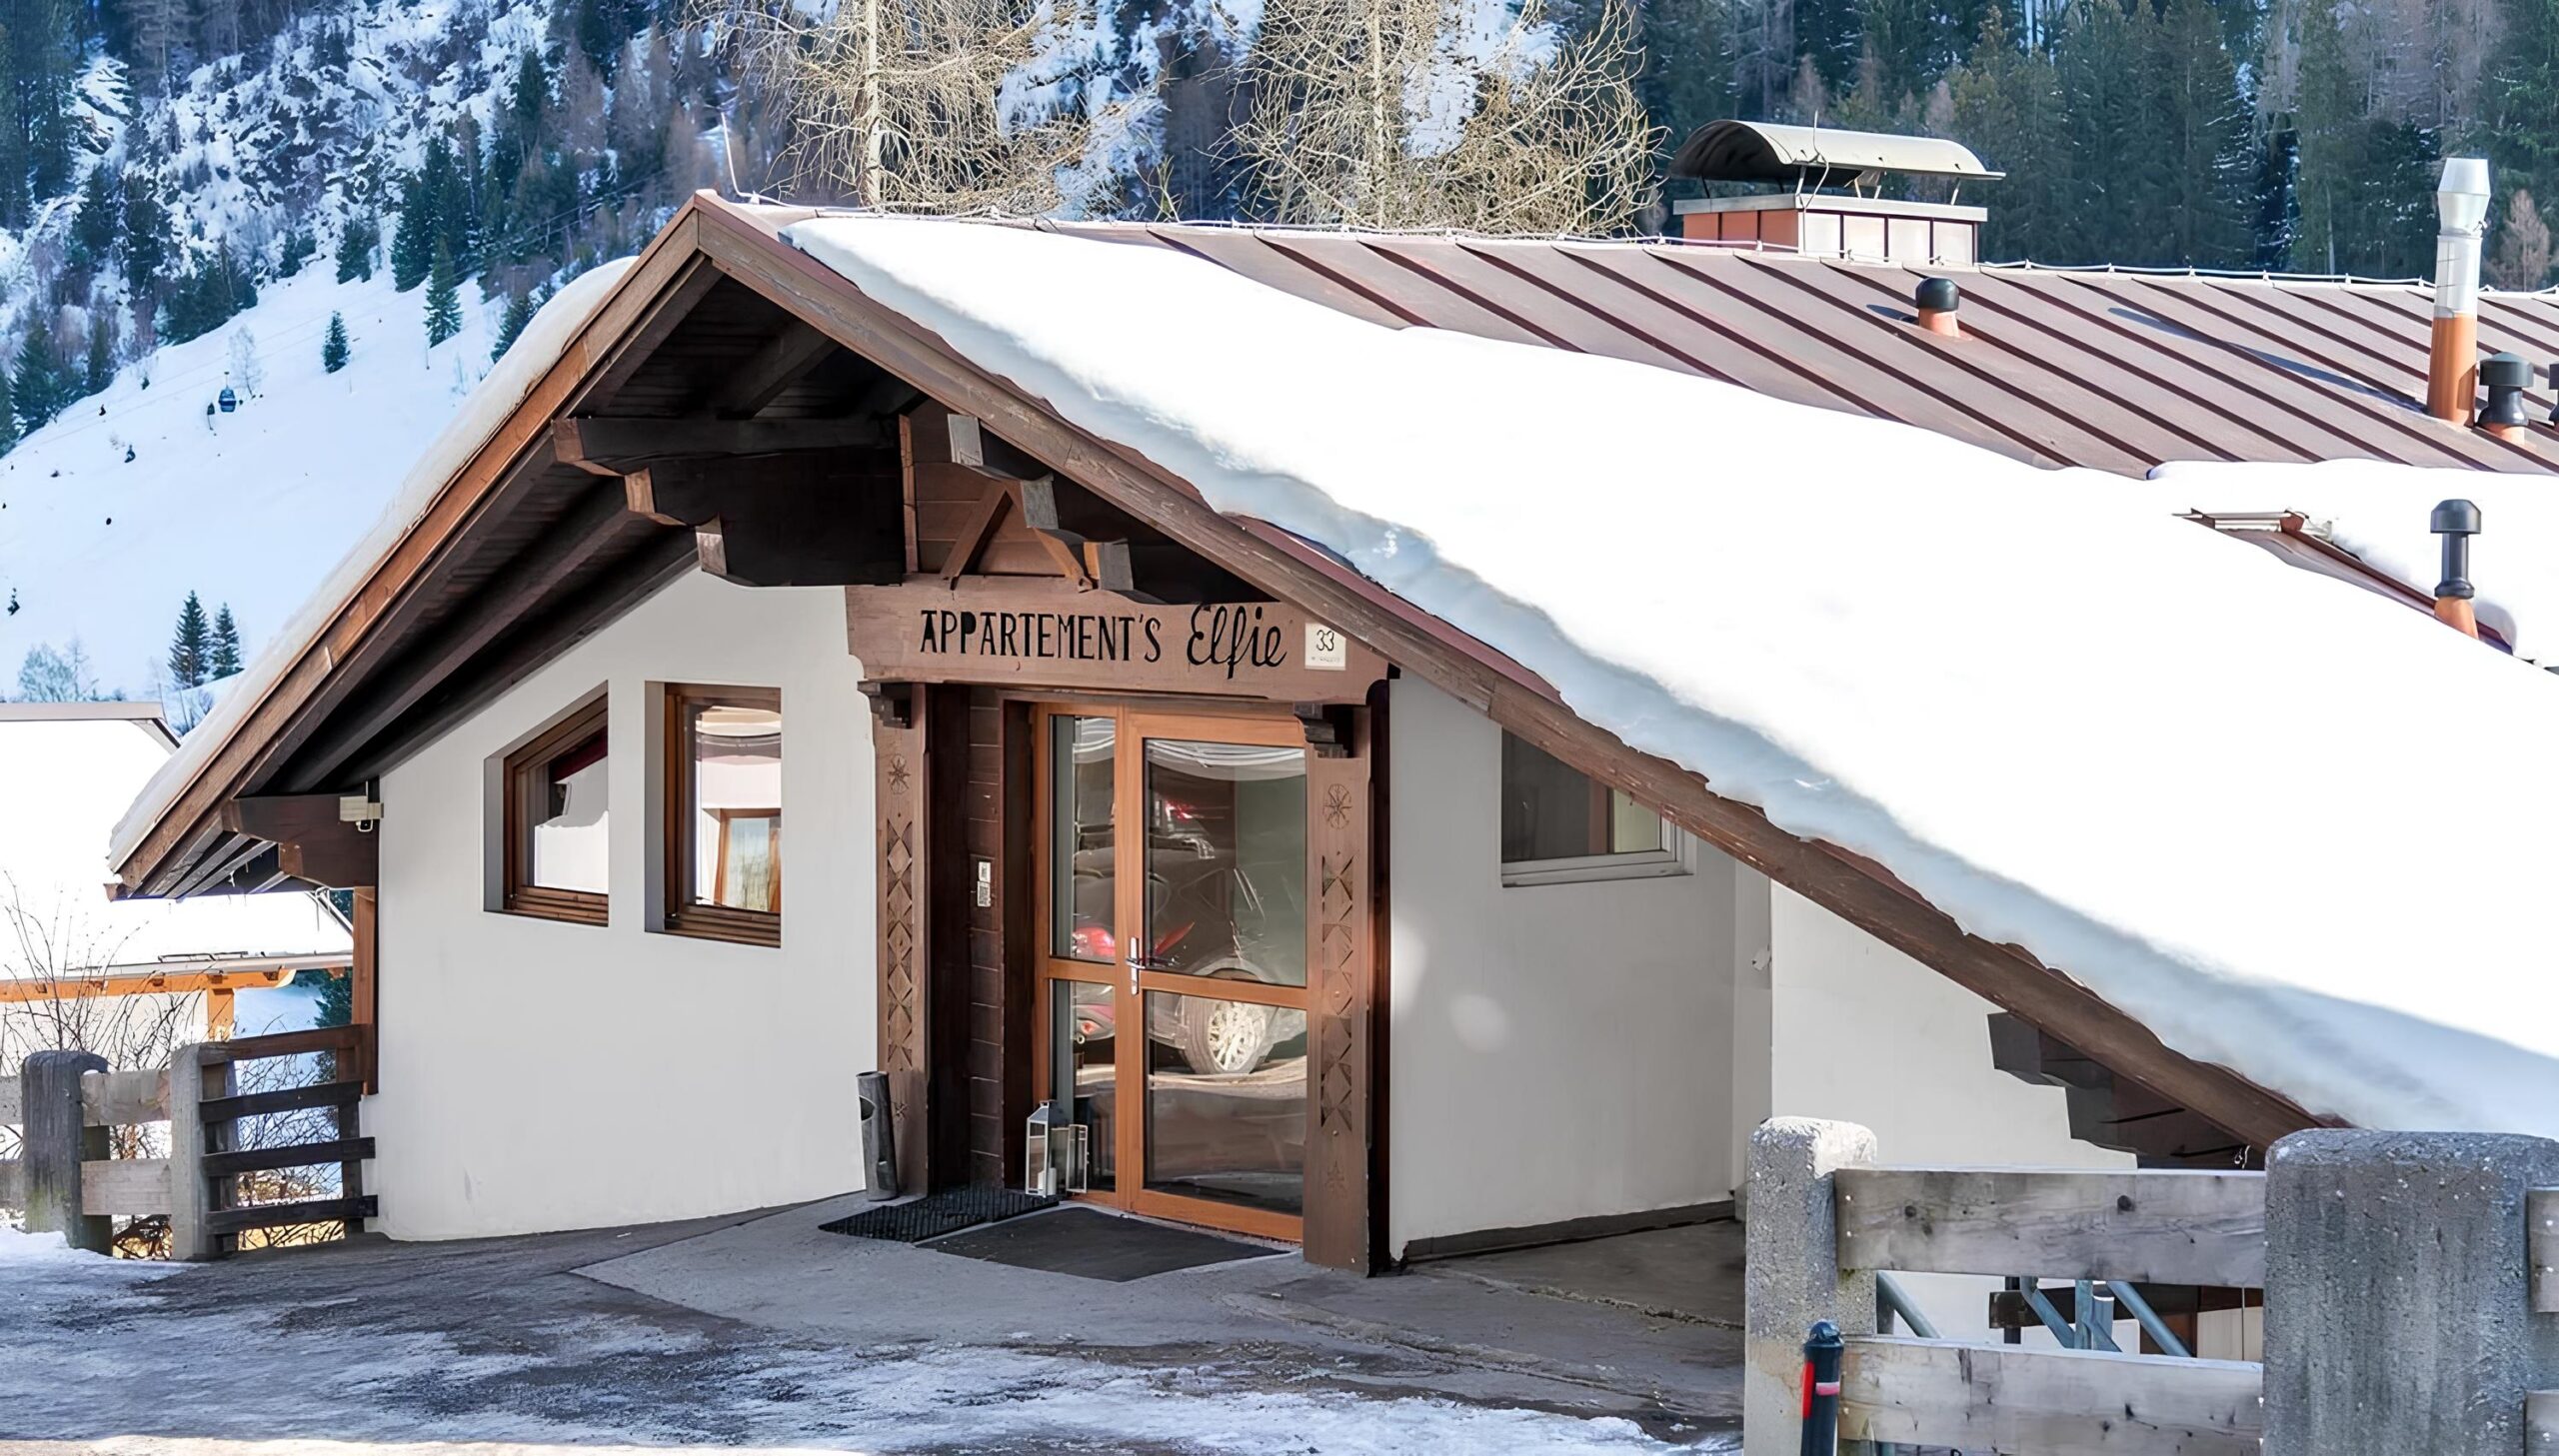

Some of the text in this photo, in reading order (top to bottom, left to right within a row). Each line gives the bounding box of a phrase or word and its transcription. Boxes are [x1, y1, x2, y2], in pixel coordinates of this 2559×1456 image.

[920, 604, 1287, 680] APPARTEMENT'S Elfie
[1315, 629, 1334, 652] 33
